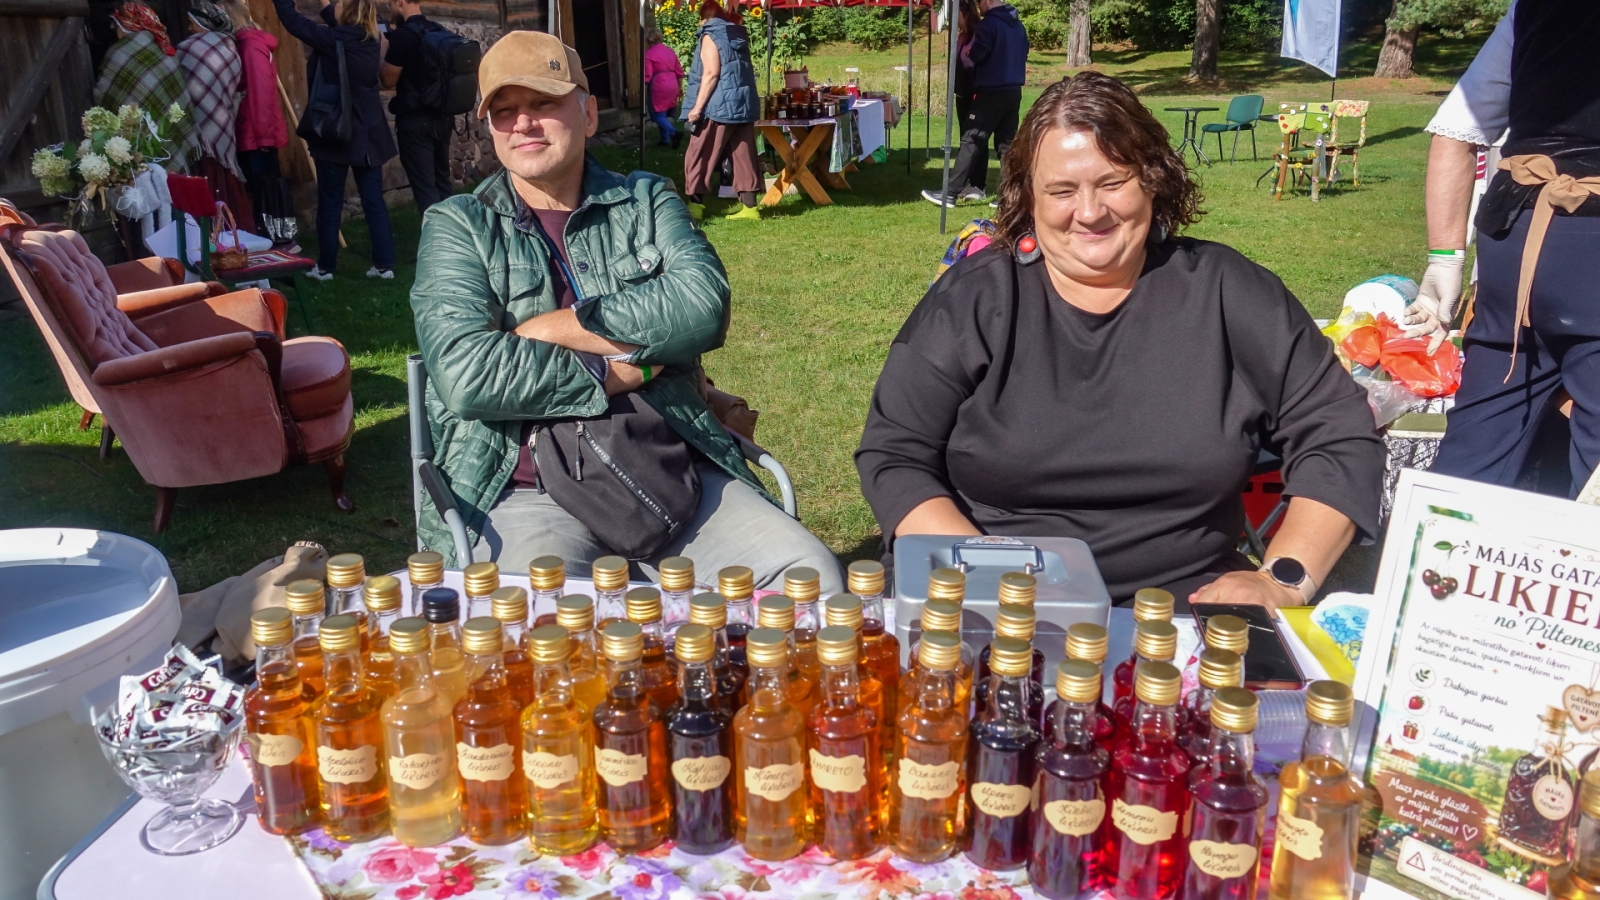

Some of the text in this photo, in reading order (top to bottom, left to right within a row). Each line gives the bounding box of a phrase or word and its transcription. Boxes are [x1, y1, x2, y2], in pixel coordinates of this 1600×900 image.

[611, 463, 635, 487] bugatti
[638, 489, 661, 513] bugatti
[1475, 545, 1543, 574] MĀJĀS
[1494, 616, 1600, 653] no Piltenes
[1510, 650, 1543, 663] gatavoti
[148, 661, 182, 688] Coffee
[1480, 693, 1508, 706] garšas
[1439, 705, 1494, 732] Pašu gatavoti
[1432, 727, 1464, 745] Lieliska
[1461, 753, 1470, 761] un
[1388, 777, 1412, 793] Mazs
[1413, 789, 1439, 803] prieks
[1394, 795, 1406, 803] ar
[1407, 799, 1430, 813] māju
[1398, 806, 1422, 822] katrā
